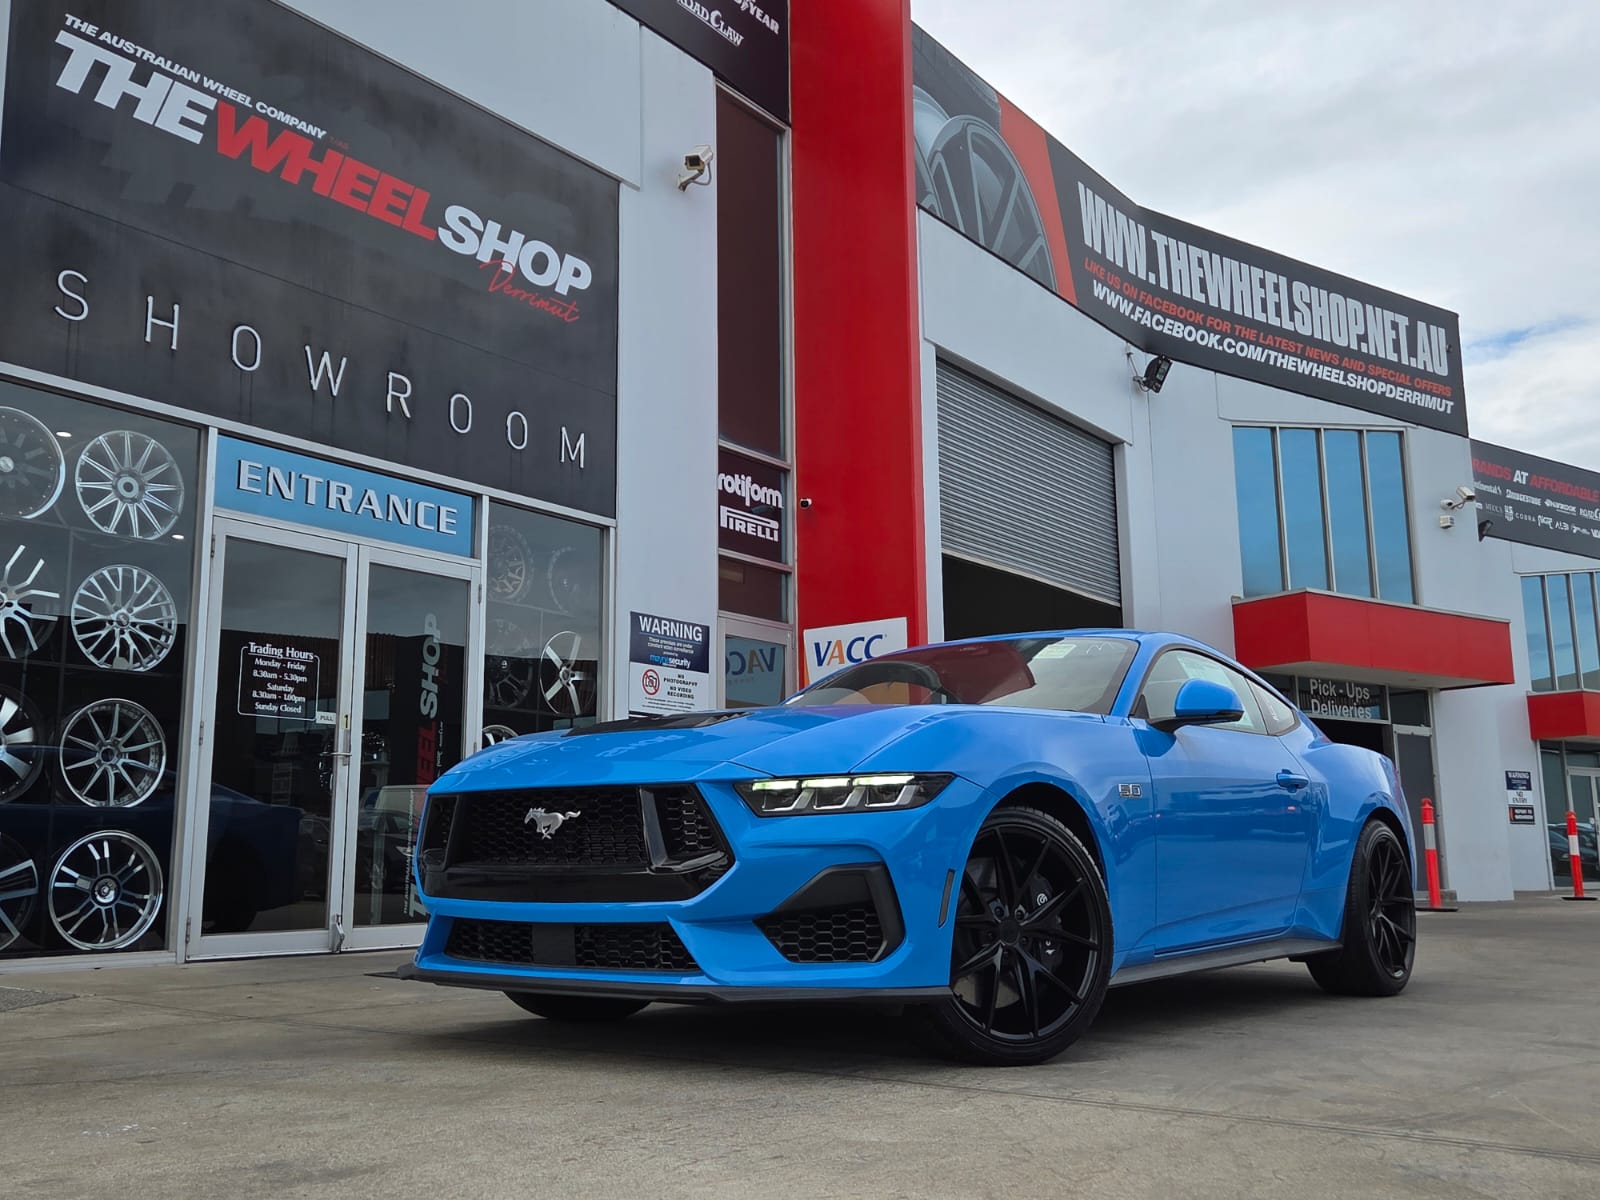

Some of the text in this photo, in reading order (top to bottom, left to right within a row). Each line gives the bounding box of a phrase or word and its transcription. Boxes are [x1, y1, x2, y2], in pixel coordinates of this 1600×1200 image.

[65, 13, 328, 139] THE AUSTRALIAN WHEEL COMPANY
[1084, 257, 1452, 397] LIKE US ON FACEBOOK FOR THE LATEST NEWS AND SPECIAL OFFERS
[1092, 279, 1454, 414] WWW.FACEBOOK.COM/THEWHEELSHOPDERRIMUT
[54, 269, 586, 469] SHOWROOM
[718, 473, 784, 508] rotiform
[1513, 469, 1529, 485] AT
[237, 459, 458, 535] ENTRANCE
[720, 505, 779, 542] PIRELLI
[639, 615, 702, 642] WARNING
[248, 642, 314, 660] Trading Hours
[255, 658, 282, 669] Monday
[287, 661, 307, 672] Friday
[420, 613, 442, 719] SHOP
[814, 634, 884, 668] VACC
[266, 683, 295, 694] Saturday
[1309, 678, 1337, 697] Pick
[1345, 682, 1370, 702] Ups
[255, 702, 302, 713] Sunday Closed
[1311, 698, 1372, 720] Deliveries
